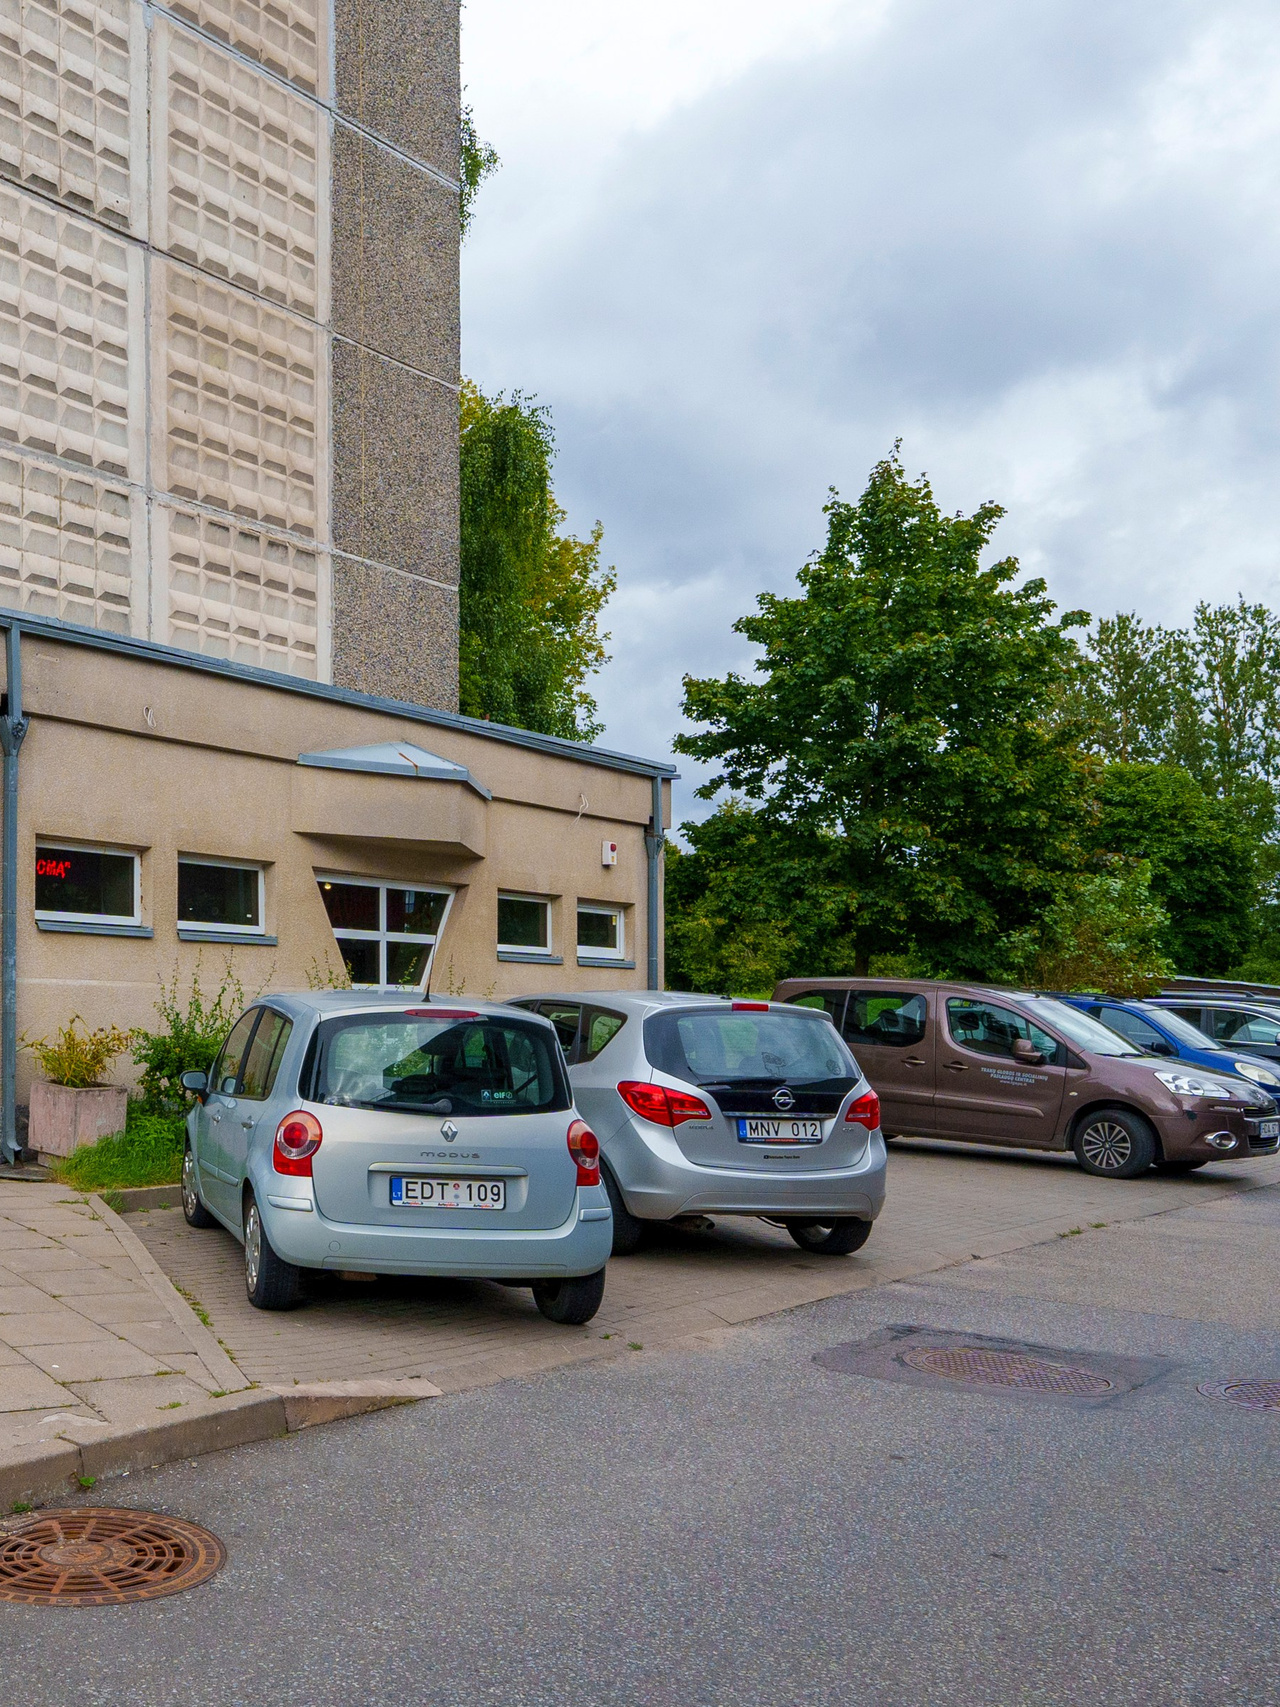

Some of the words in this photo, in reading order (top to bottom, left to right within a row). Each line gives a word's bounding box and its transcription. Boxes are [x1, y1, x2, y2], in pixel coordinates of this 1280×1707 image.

[749, 1121, 781, 1136] MNV
[791, 1122, 818, 1137] 012
[405, 1181, 449, 1200] EDT
[466, 1183, 501, 1203] 109
